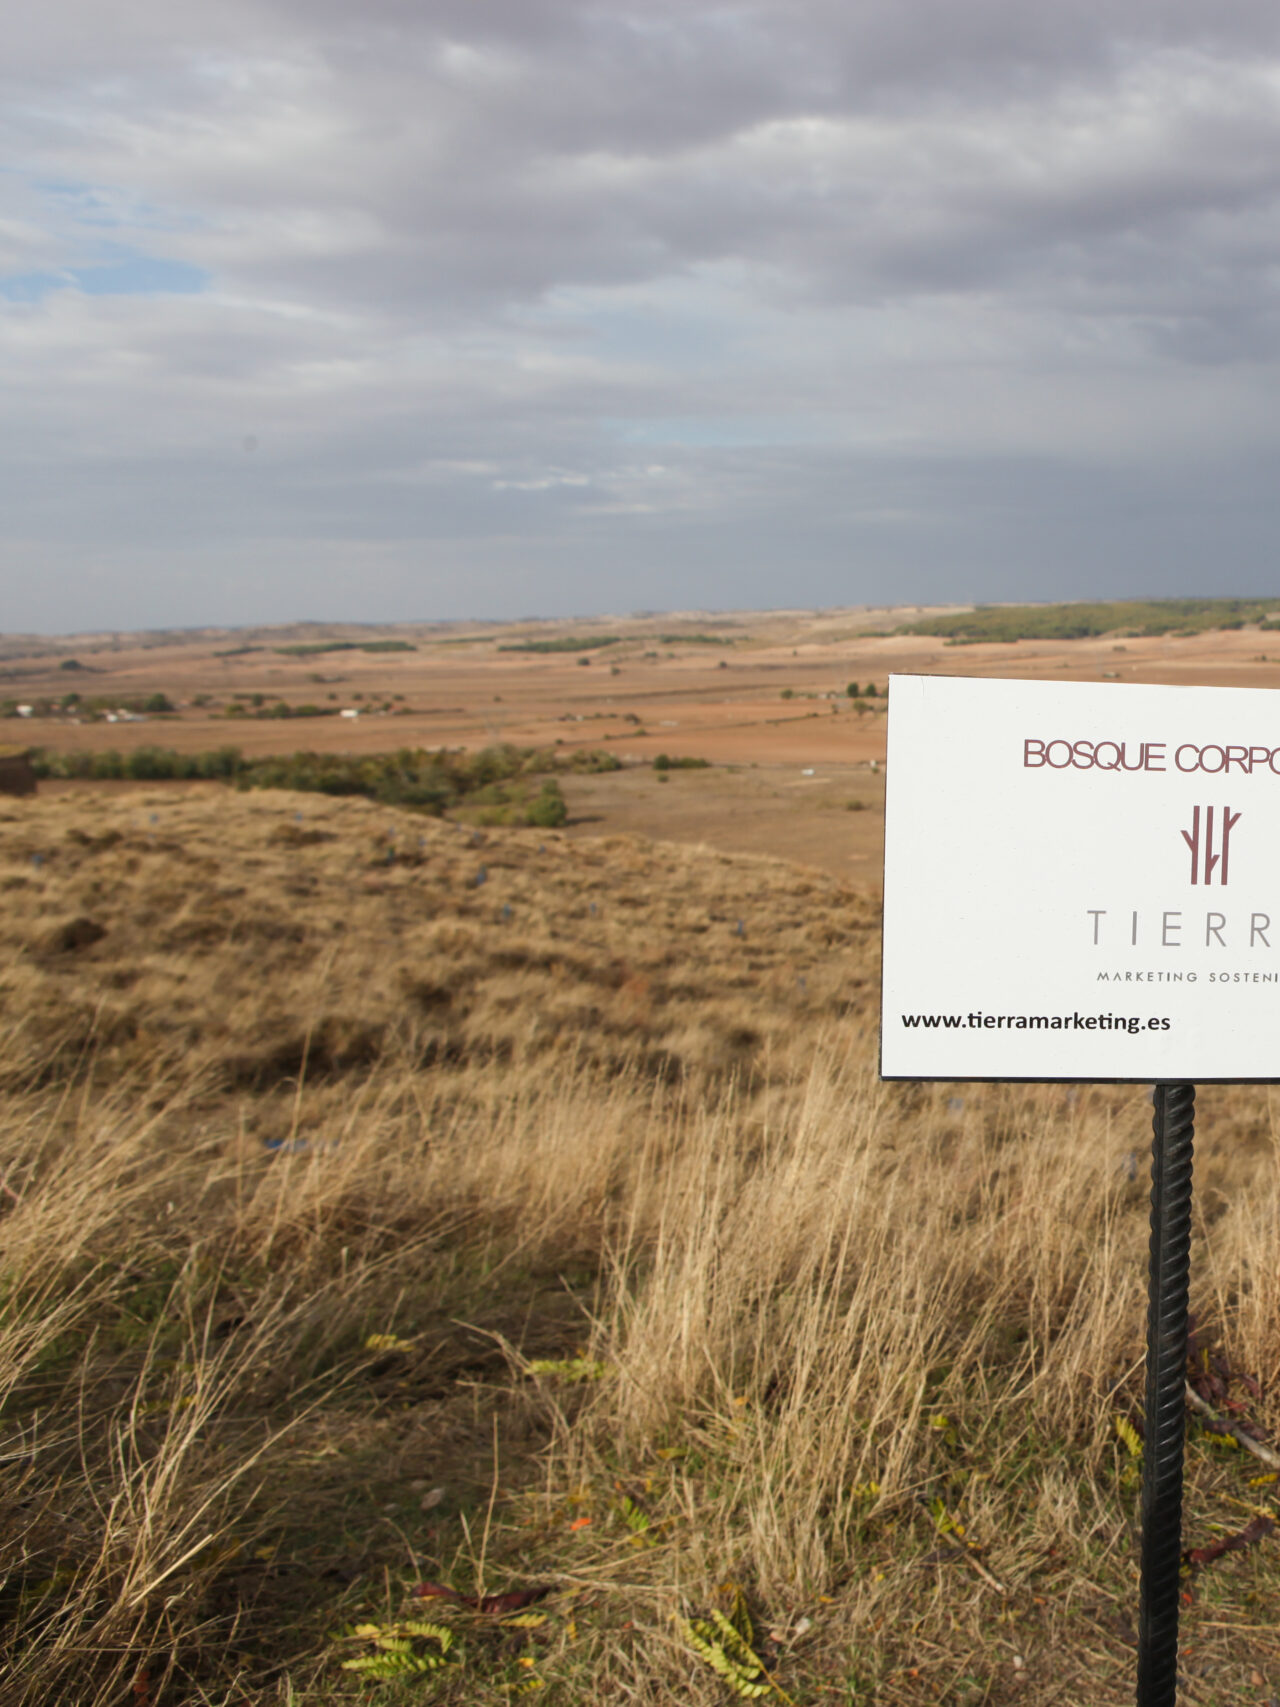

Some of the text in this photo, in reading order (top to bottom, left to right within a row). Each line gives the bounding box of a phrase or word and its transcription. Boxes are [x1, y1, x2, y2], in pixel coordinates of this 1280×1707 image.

[1023, 739, 1167, 772] BOSQUE
[1096, 971, 1198, 983] MARKETING
[901, 1010, 1171, 1035] www.tierramarketing.es
